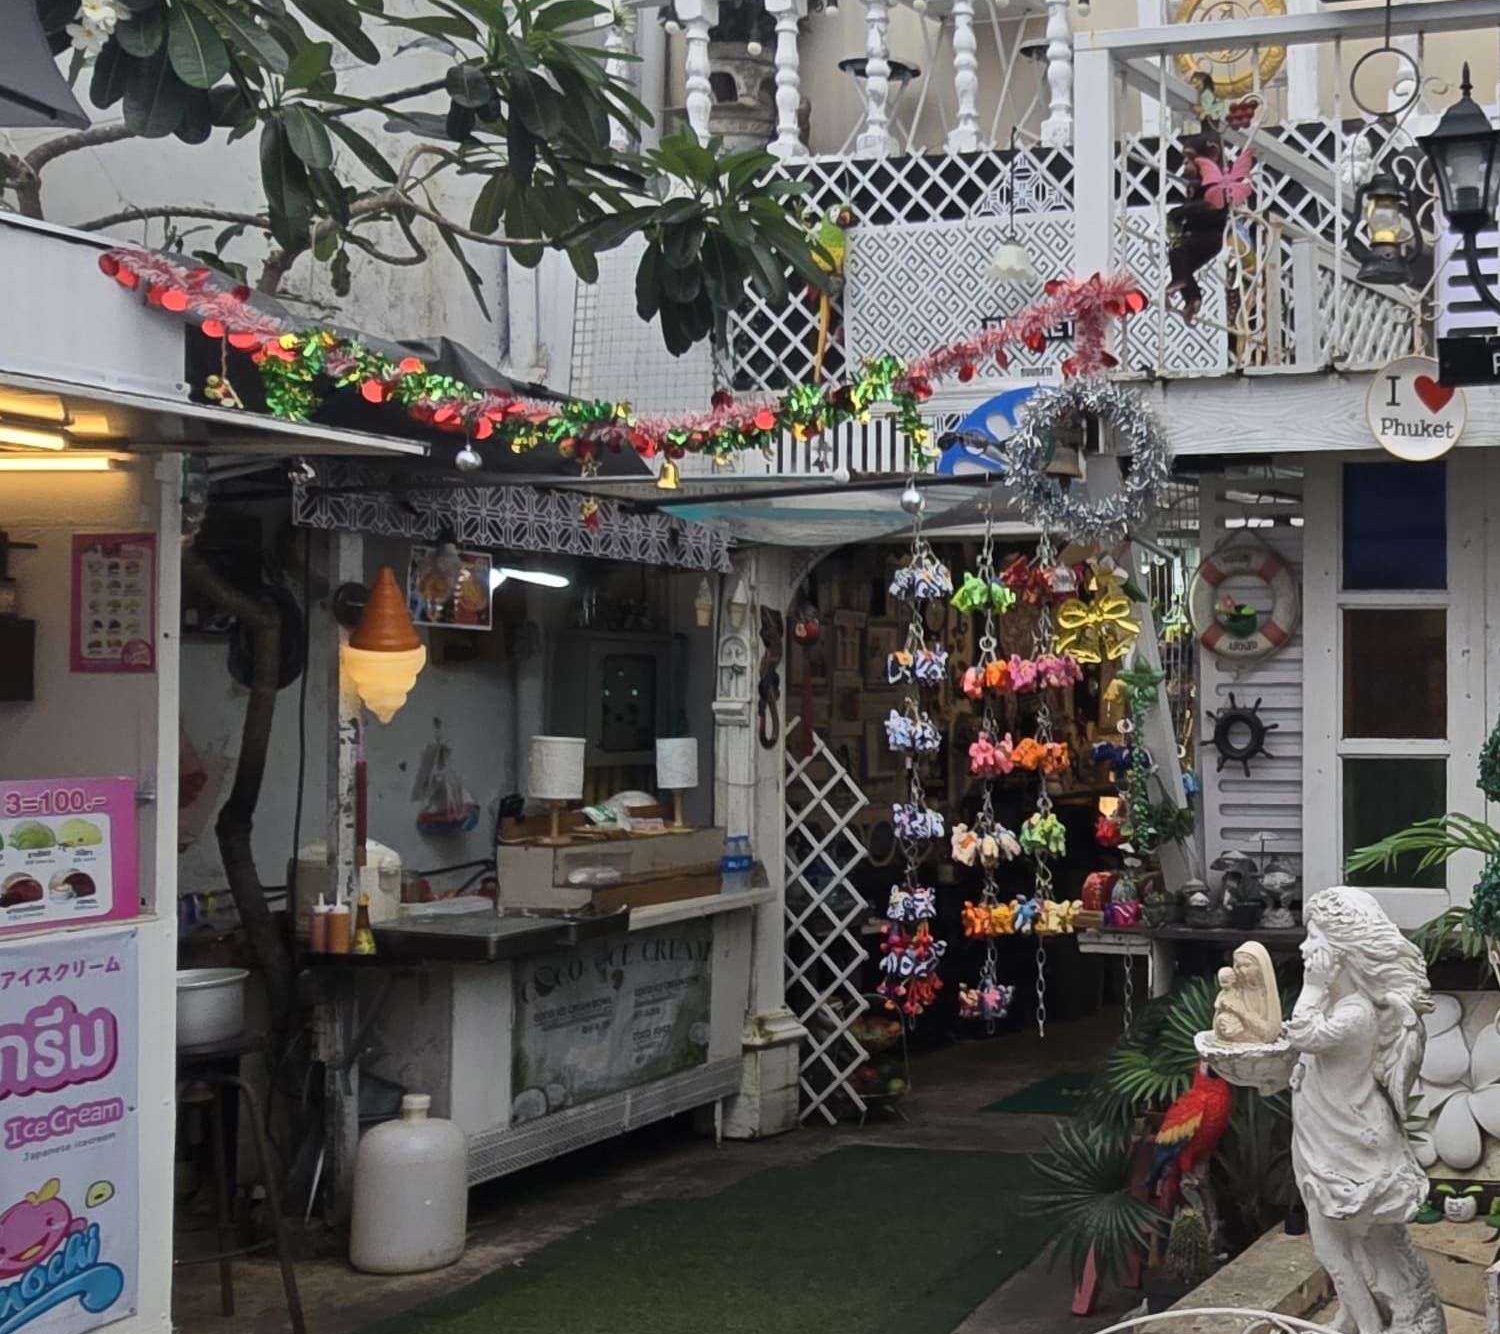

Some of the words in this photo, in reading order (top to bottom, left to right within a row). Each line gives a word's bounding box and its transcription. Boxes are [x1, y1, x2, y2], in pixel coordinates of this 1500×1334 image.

[1386, 375, 1401, 407] I
[1381, 417, 1455, 440] Phuket
[1, 956, 120, 990] アイスクリーム
[23, 1143, 71, 1161] Japanese
